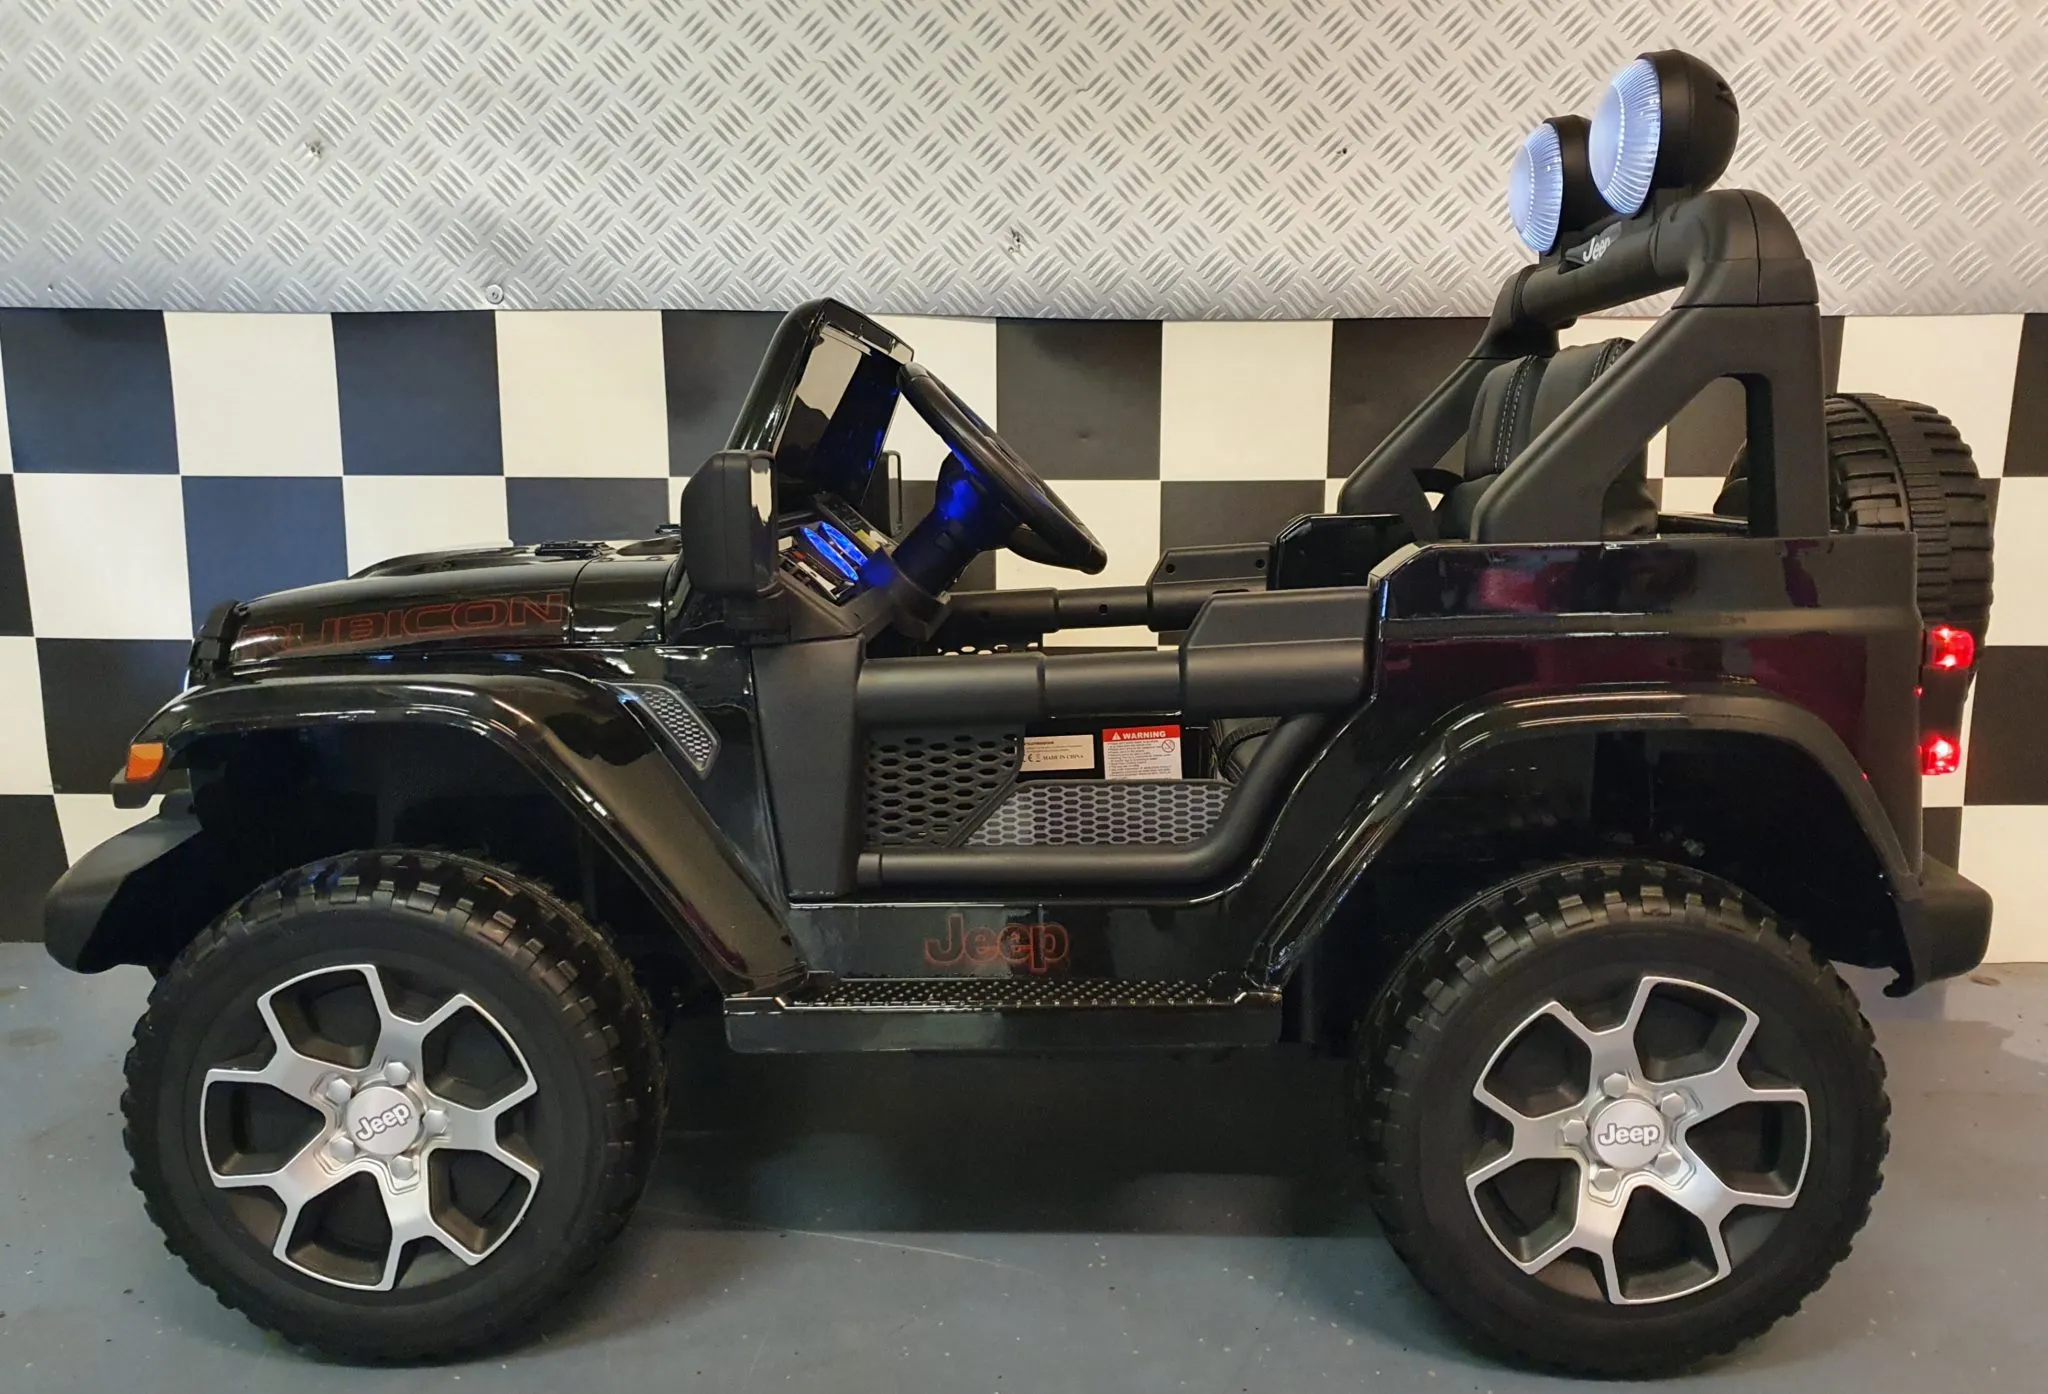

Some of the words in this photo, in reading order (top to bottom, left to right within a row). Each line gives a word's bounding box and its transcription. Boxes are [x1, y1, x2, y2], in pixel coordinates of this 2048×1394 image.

[234, 593, 564, 660] RUBICON
[1122, 730, 1166, 740] WARNING
[924, 912, 1070, 974] Jeep
[356, 1103, 411, 1141] Jeep
[1598, 1123, 1660, 1146] Jeep
